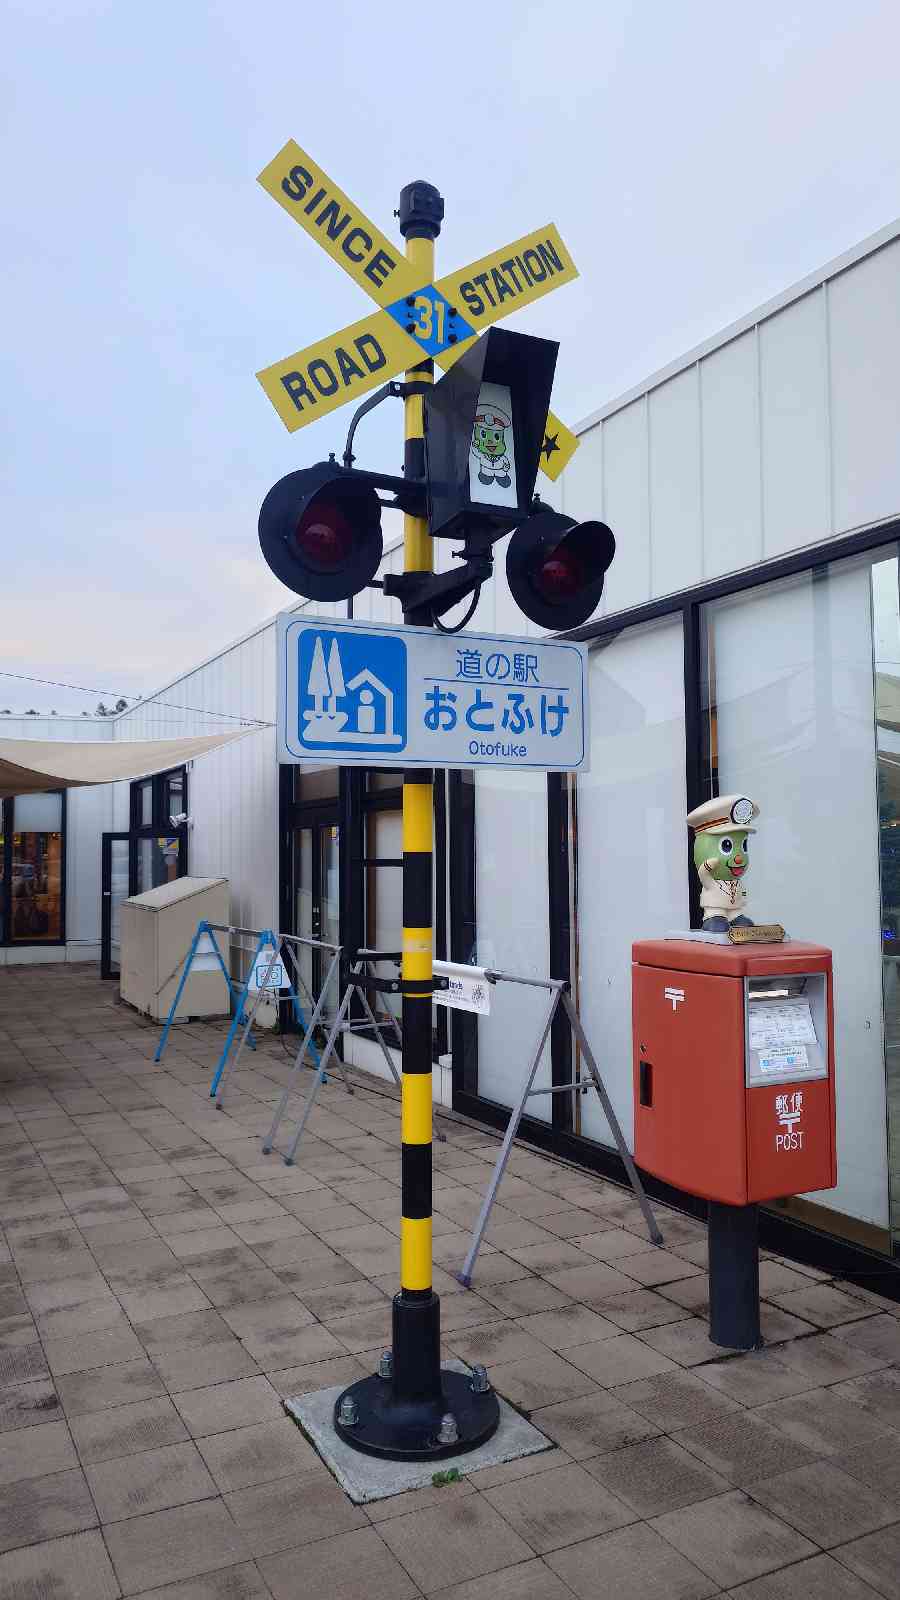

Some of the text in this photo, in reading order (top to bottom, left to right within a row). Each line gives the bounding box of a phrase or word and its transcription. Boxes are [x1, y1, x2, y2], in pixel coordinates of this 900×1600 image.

[281, 165, 397, 289] SINCE
[280, 239, 565, 412] ROAD STATION
[413, 296, 446, 345] 31
[456, 649, 540, 683] 道の駅
[423, 685, 570, 738] おとふけ
[468, 741, 527, 757] Otofuke
[776, 1092, 804, 1115] 郵便
[776, 1131, 804, 1152] POST
